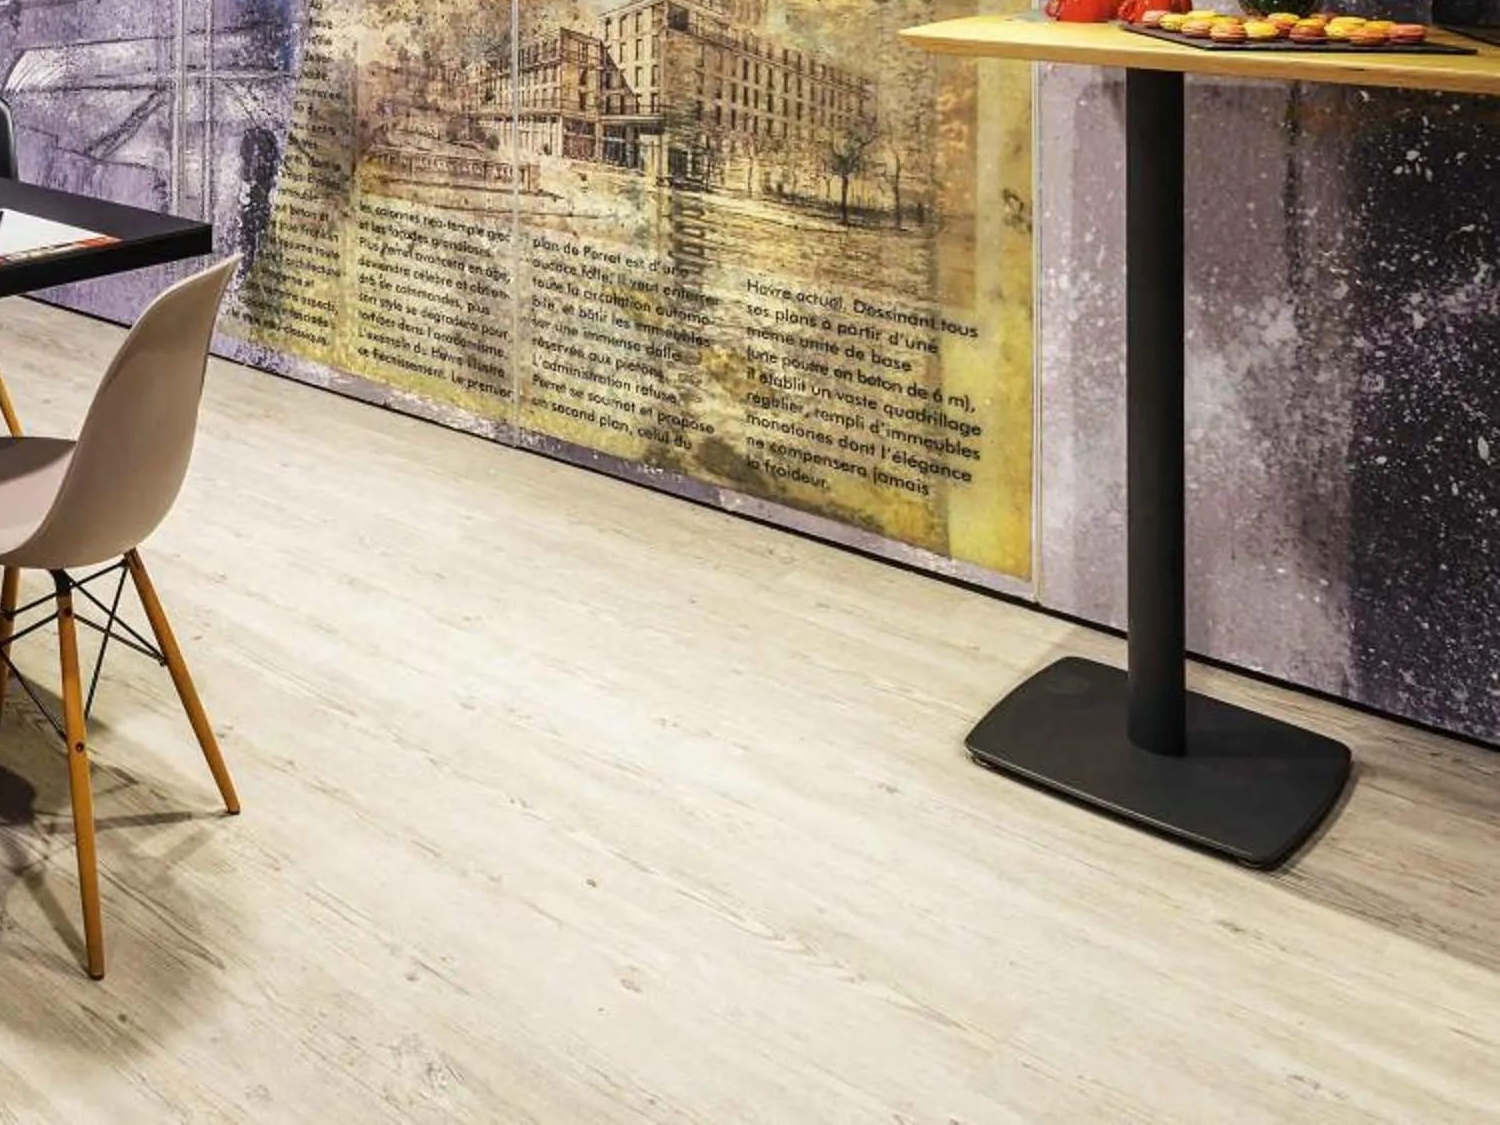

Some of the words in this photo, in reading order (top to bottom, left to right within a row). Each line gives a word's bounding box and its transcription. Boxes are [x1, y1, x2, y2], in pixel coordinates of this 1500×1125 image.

[562, 241, 580, 257] de
[582, 245, 622, 265] Perret
[583, 289, 652, 314] circulation
[746, 278, 793, 301] Havre
[852, 298, 936, 330] Dessinant
[941, 319, 980, 340] tous
[774, 307, 818, 329] plans
[836, 322, 884, 345] partir
[532, 353, 632, 393] L'administration
[844, 343, 867, 362] de
[870, 349, 913, 373] base
[833, 367, 854, 383] en
[906, 381, 929, 401] de
[932, 386, 945, 405] 6
[551, 400, 596, 423] second
[657, 410, 716, 435] propose
[810, 384, 832, 400] un
[834, 389, 879, 411] vaste
[882, 401, 983, 438] quadrillage
[746, 414, 834, 446] monotones
[837, 435, 877, 457] dont
[880, 444, 973, 484] l'élégance
[813, 407, 867, 432] rempli
[868, 420, 981, 462] d'immeubles
[746, 435, 766, 451] ne
[768, 440, 869, 479] compensera
[871, 465, 931, 497] jamais
